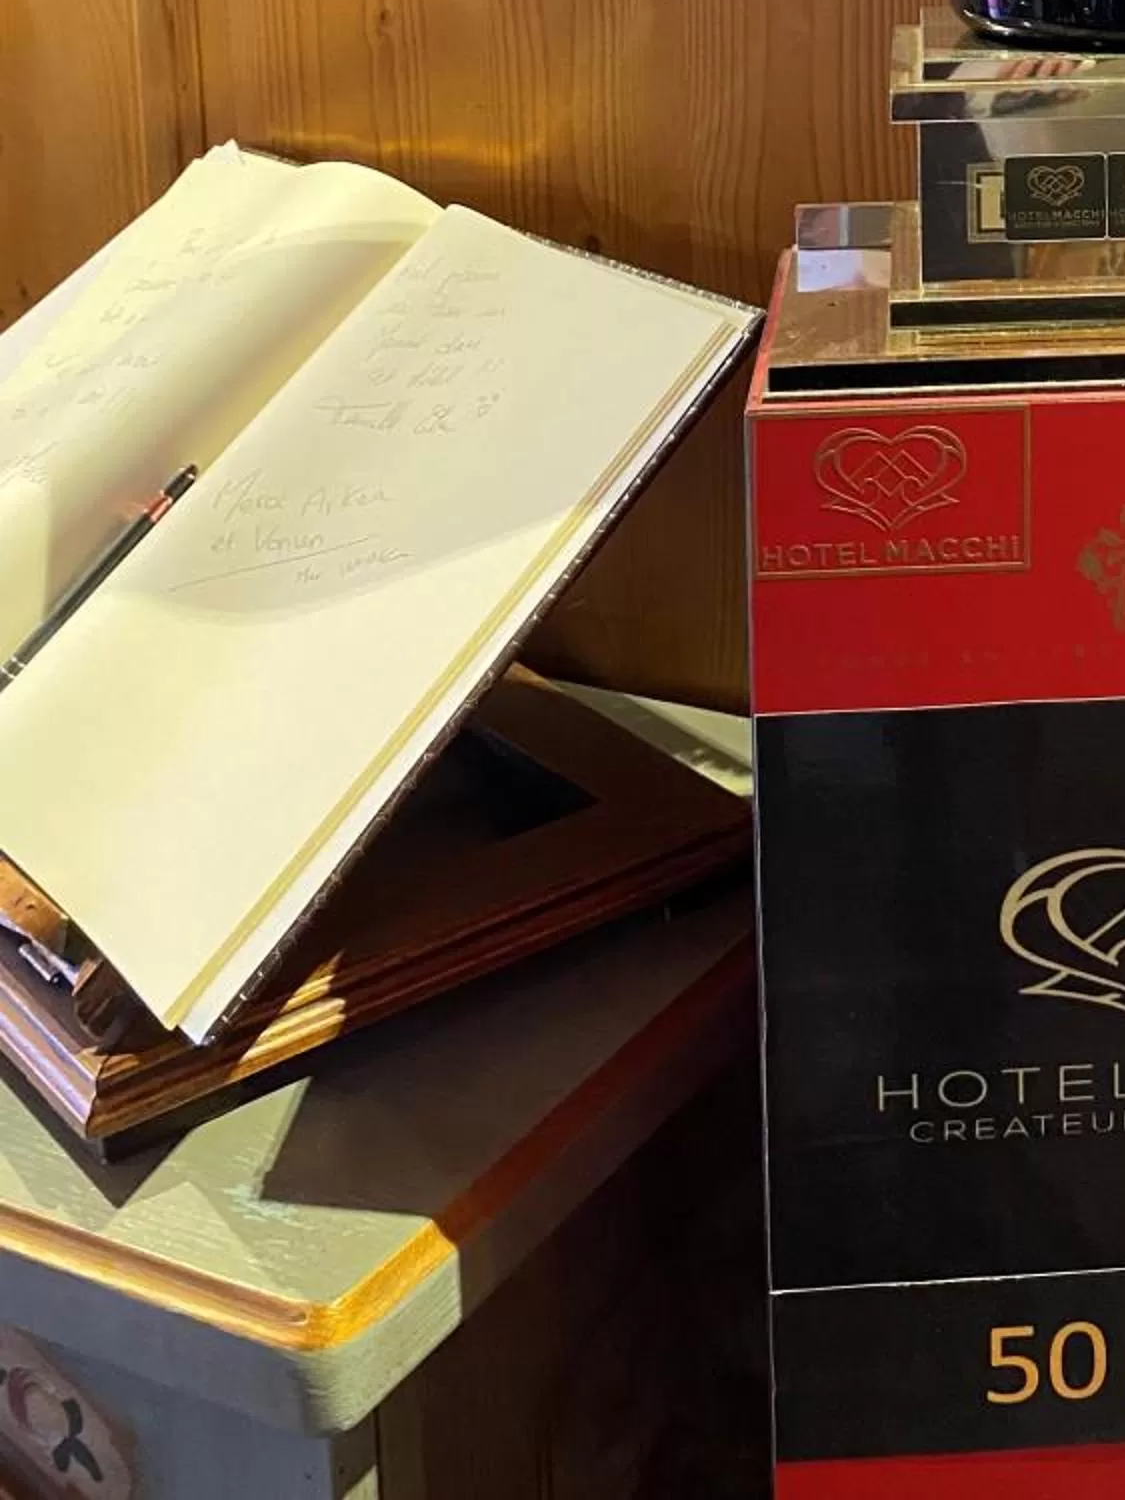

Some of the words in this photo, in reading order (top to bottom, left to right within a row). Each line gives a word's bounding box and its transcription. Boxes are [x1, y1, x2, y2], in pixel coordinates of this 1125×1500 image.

[762, 542, 878, 570] HOTEL
[885, 535, 1023, 563] MACCHI
[985, 1320, 1107, 1405] 50
